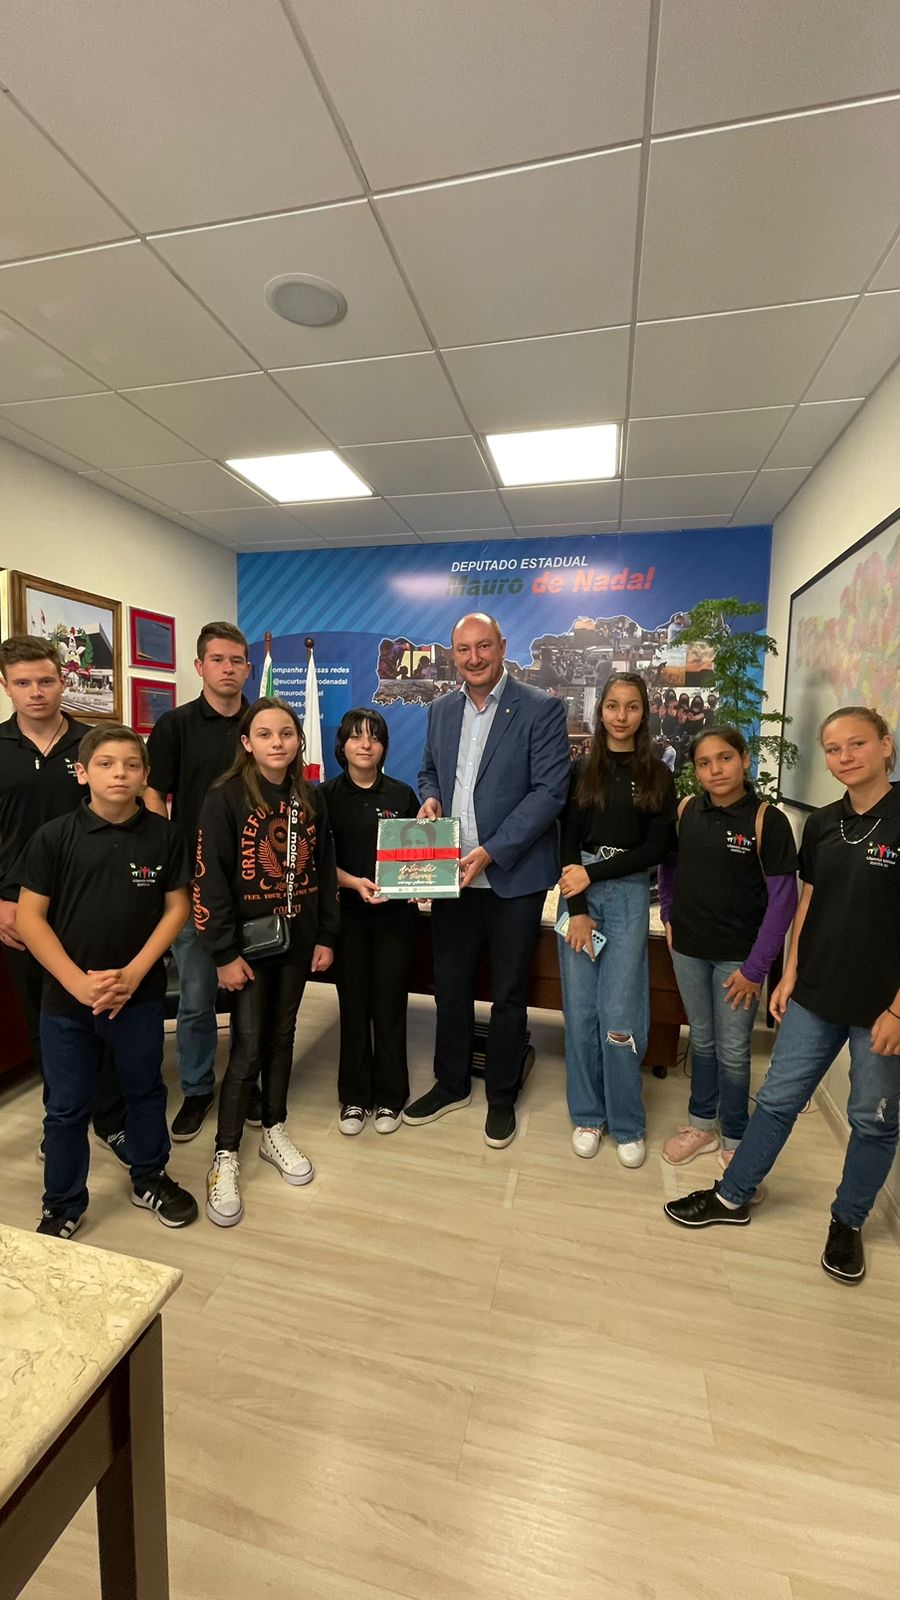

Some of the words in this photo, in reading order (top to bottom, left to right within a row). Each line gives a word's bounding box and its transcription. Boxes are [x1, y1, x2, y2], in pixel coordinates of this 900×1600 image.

[451, 559, 517, 572] DEPUTADO
[520, 556, 589, 569] ESTADUAL
[447, 576, 524, 596] Mauro
[531, 571, 566, 594] de
[572, 567, 656, 593] Nadal
[241, 806, 270, 881] GRATEFU
